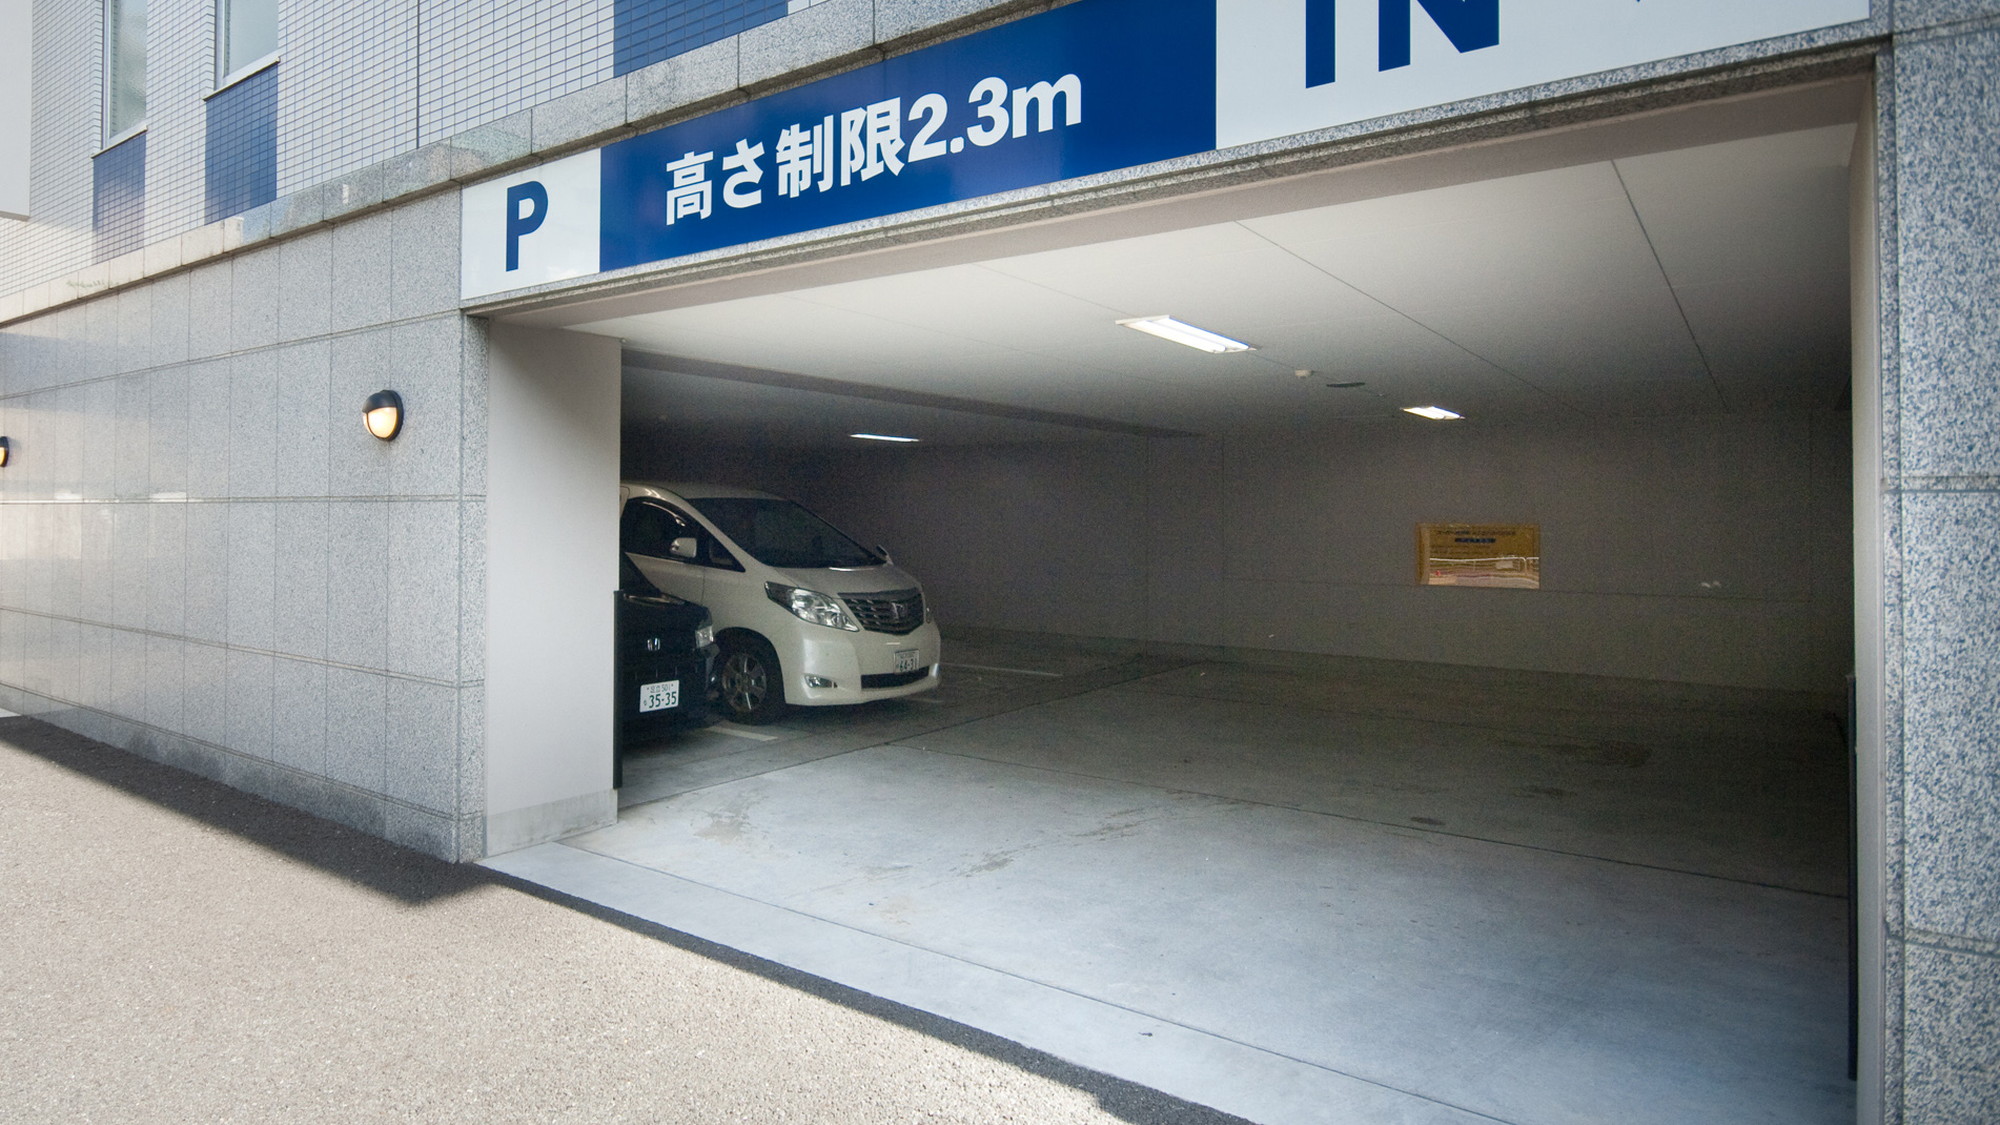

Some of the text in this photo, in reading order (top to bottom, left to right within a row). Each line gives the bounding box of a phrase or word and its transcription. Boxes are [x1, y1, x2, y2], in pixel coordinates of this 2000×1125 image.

[666, 73, 1081, 226] 高さ制限2.3m
[506, 180, 549, 272] P
[649, 691, 677, 709] 35-35
